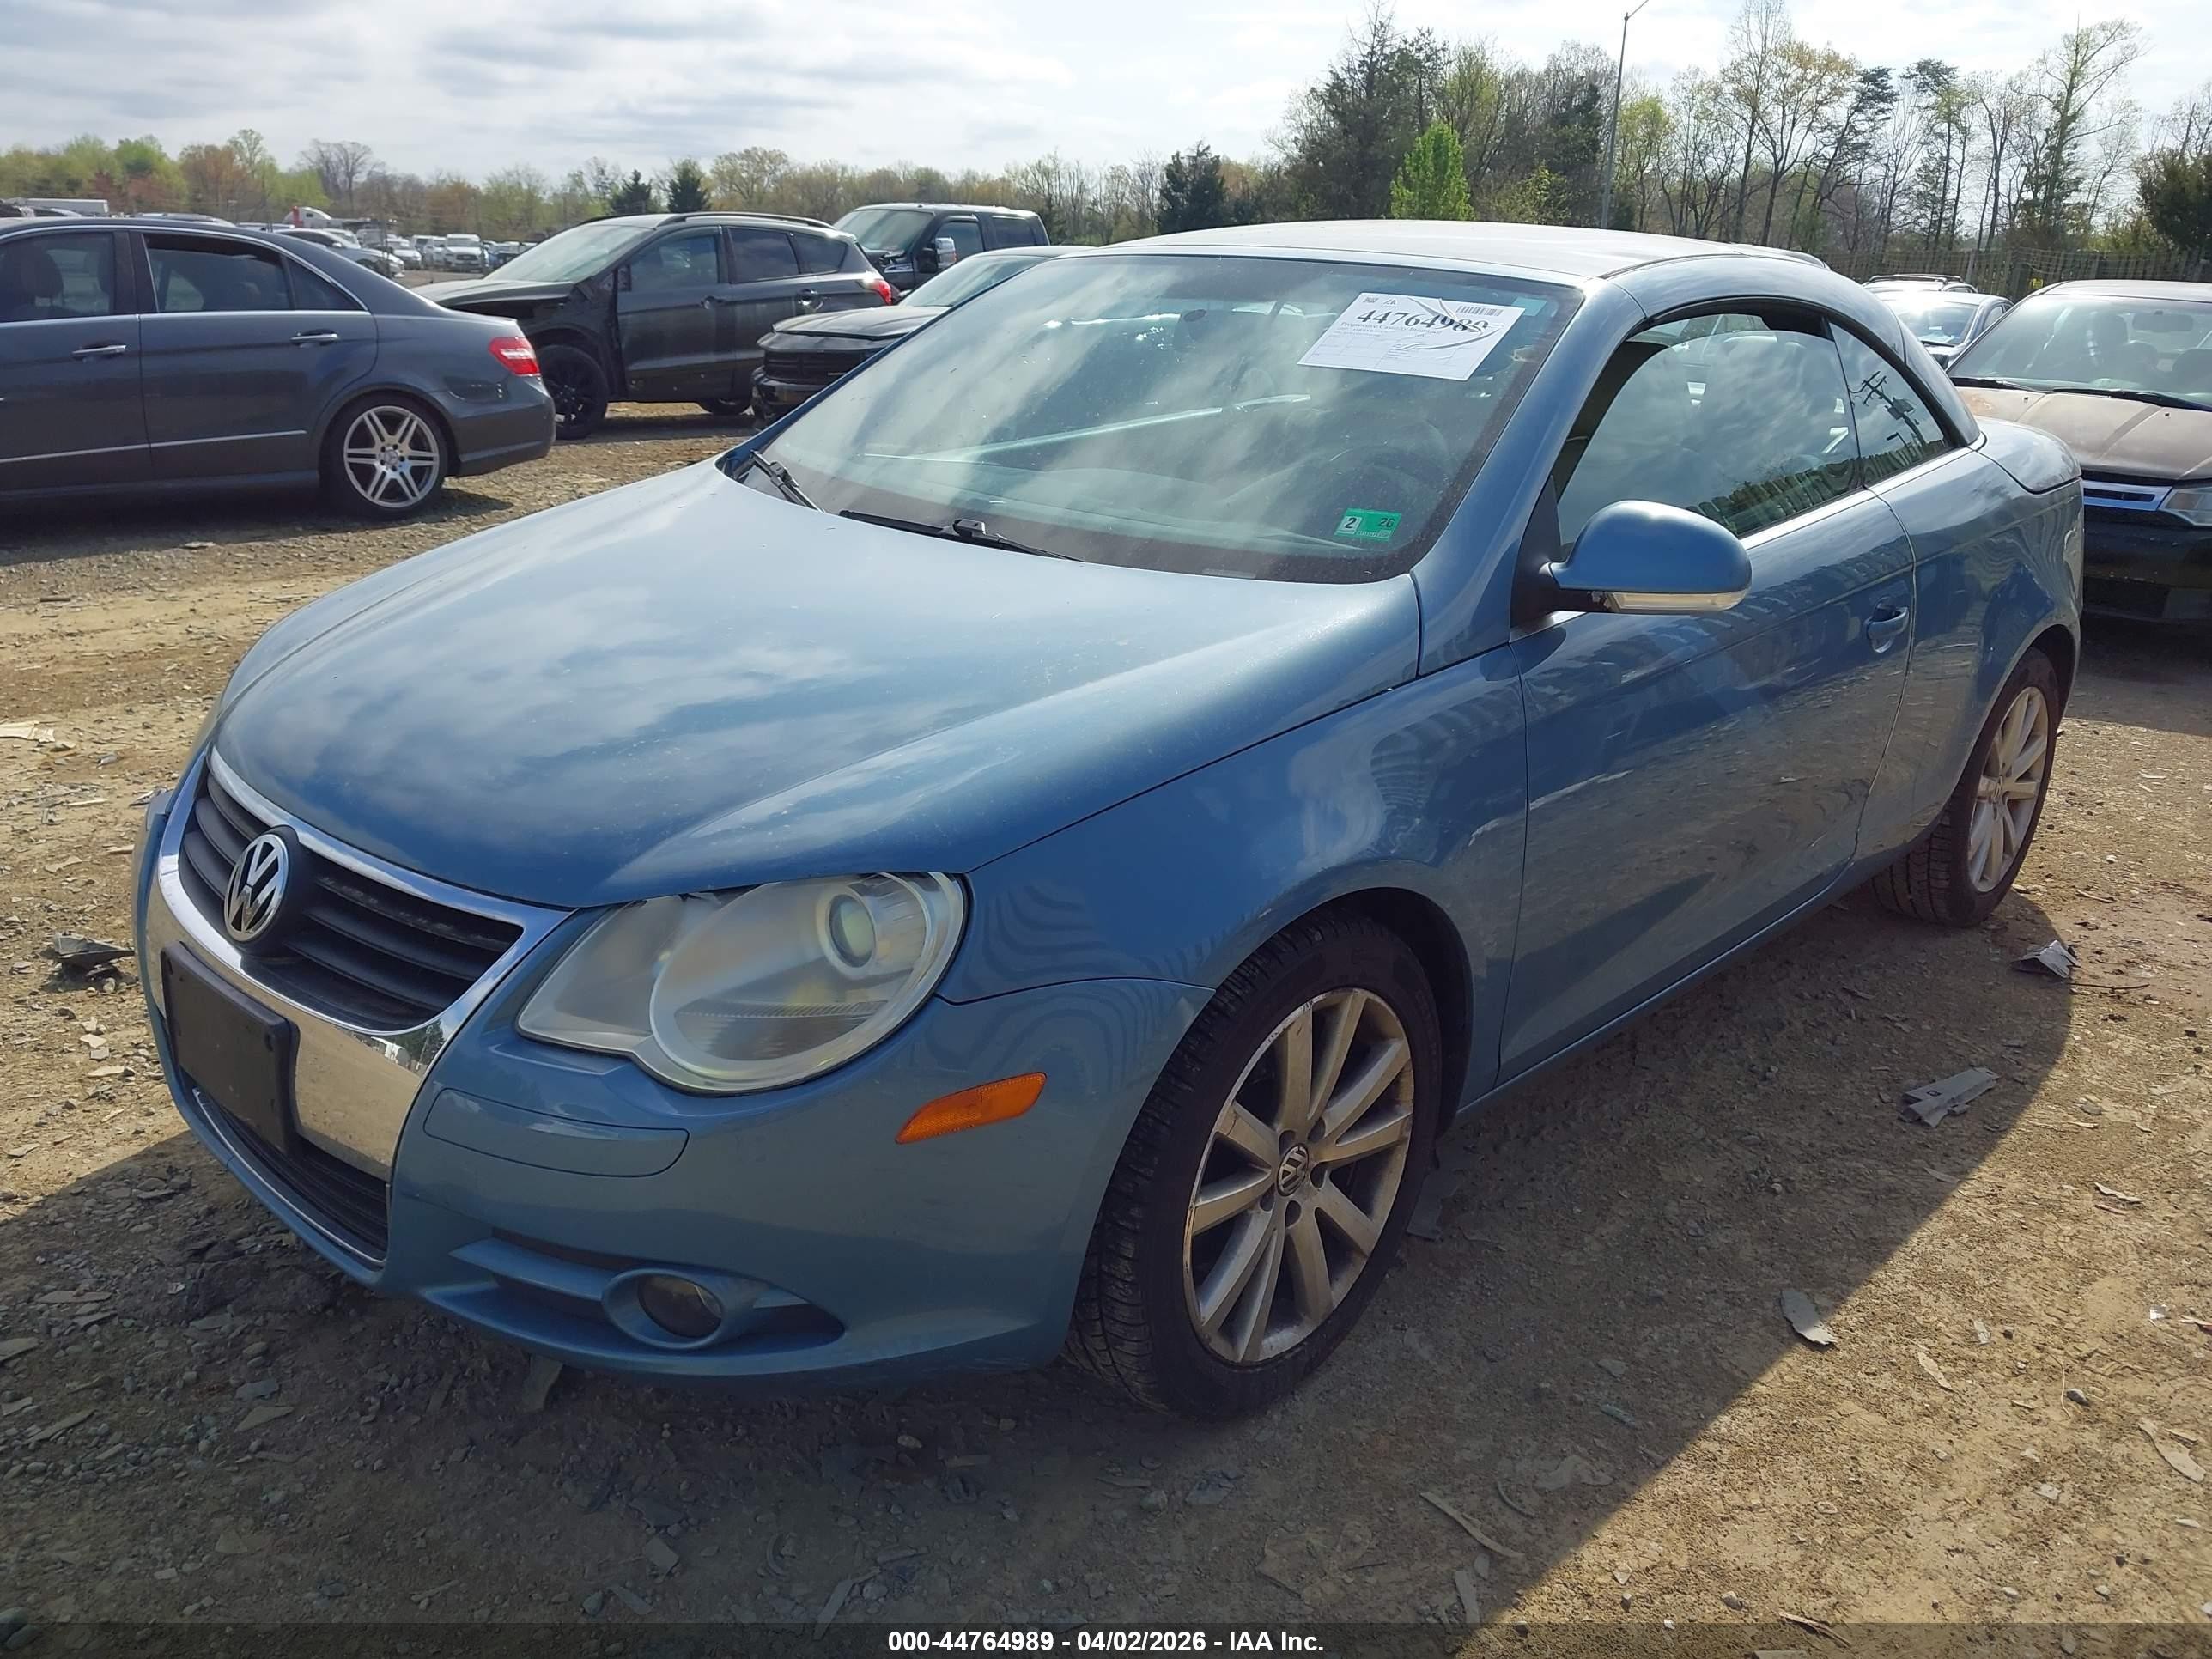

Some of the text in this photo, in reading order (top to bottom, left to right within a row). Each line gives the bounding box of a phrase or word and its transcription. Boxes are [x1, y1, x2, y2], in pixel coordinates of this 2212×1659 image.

[1345, 517, 1395, 529] 2 26
[224, 833, 289, 942] VW
